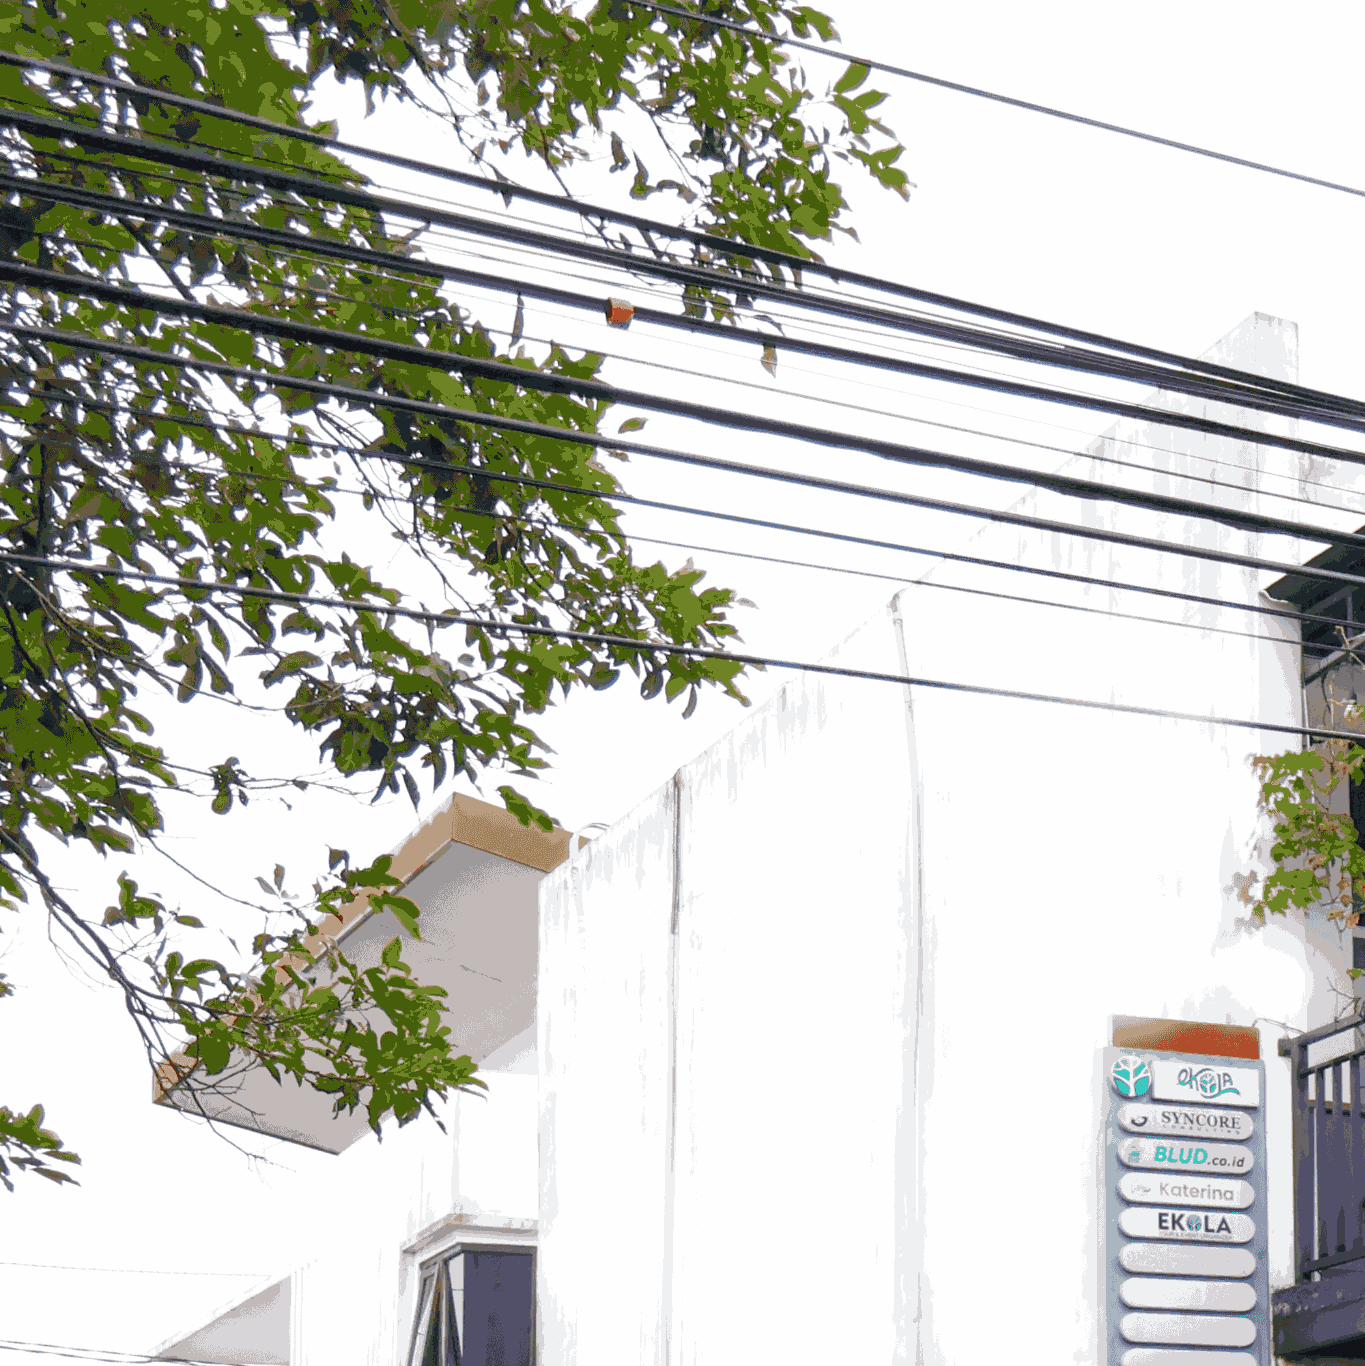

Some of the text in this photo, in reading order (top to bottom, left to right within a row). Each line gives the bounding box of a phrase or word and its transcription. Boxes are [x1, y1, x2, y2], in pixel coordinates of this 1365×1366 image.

[1161, 1111, 1241, 1129] SYNCORE
[1154, 1146, 1245, 1167] BLUD.co.id
[1159, 1182, 1234, 1200] Katerina
